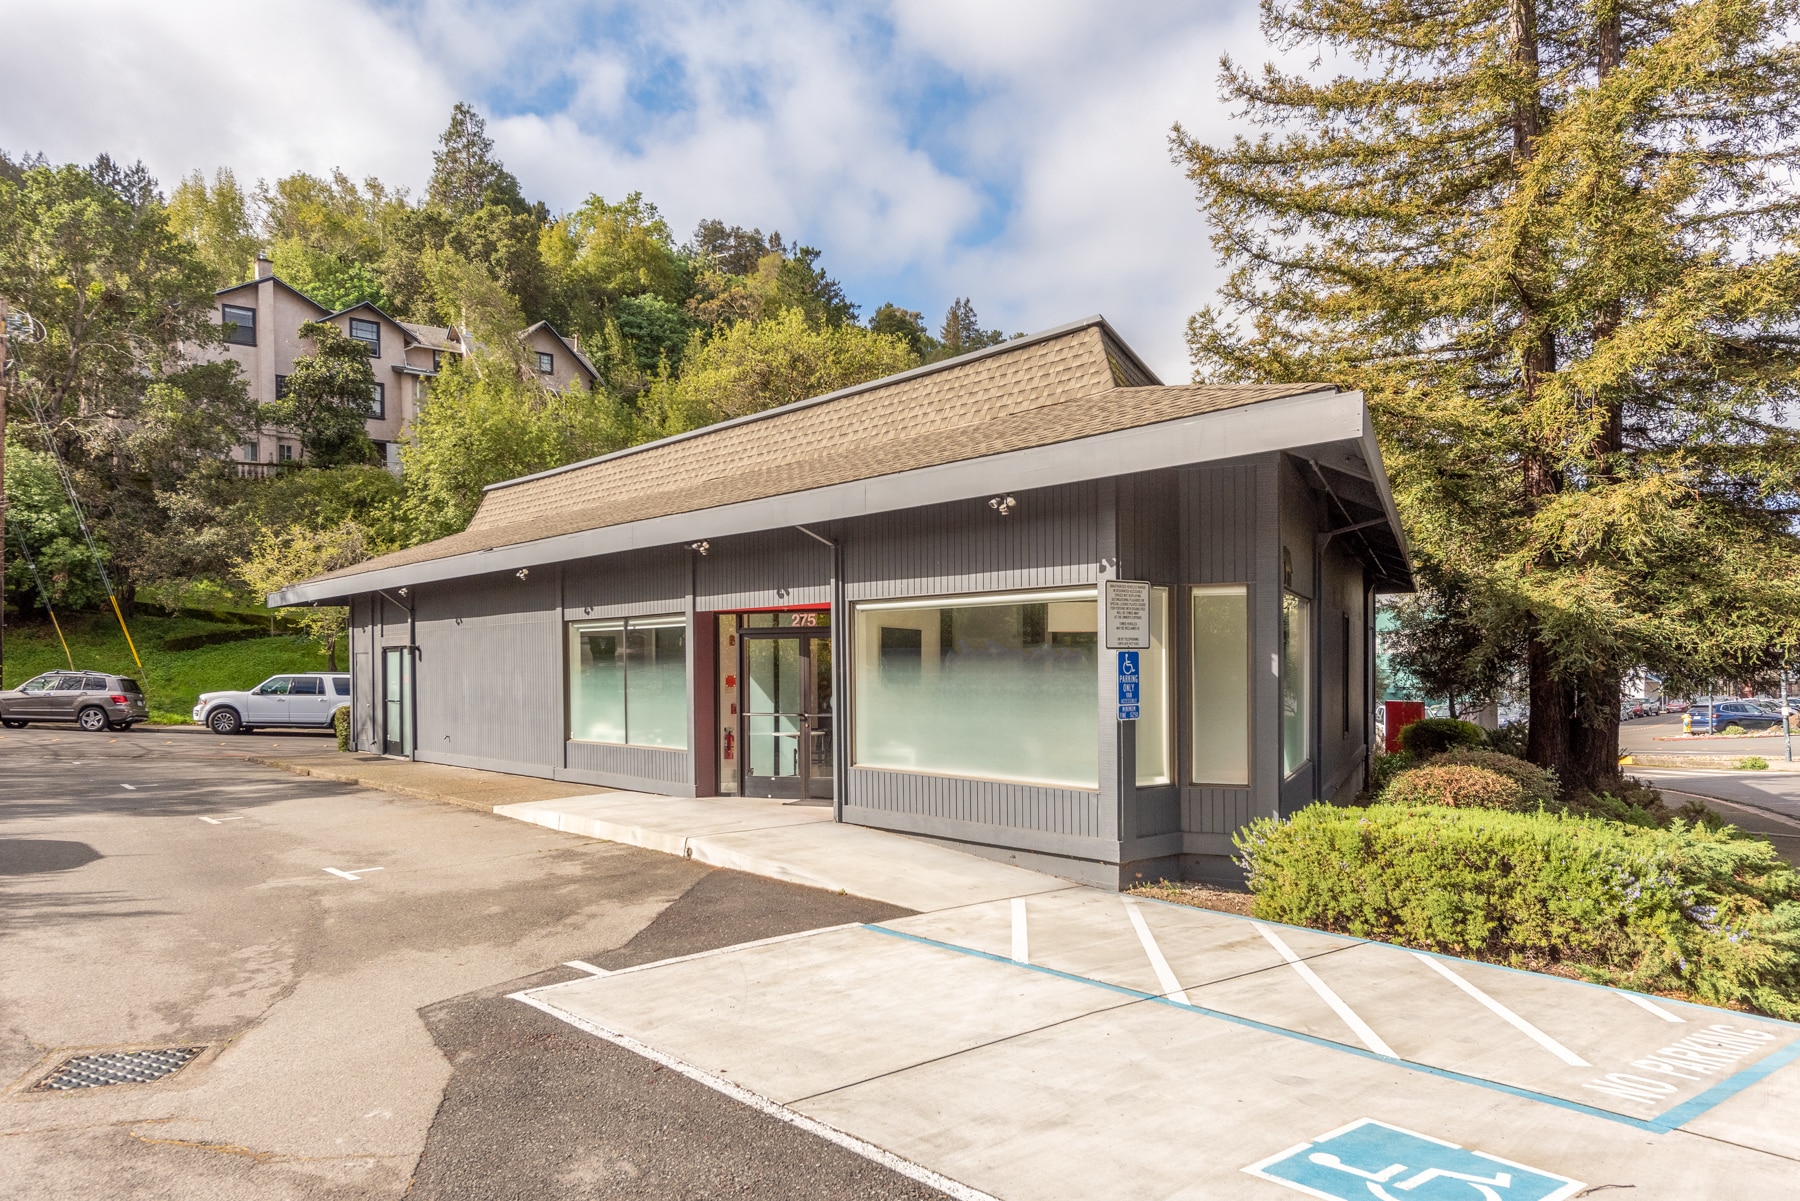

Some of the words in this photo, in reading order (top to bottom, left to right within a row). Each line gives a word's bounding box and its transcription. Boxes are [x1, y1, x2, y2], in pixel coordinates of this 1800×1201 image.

[791, 613, 816, 627] 275
[1120, 675, 1138, 683] PARKING
[1122, 684, 1135, 692] ONLY
[1630, 1024, 1777, 1081] PARKING
[1581, 1072, 1680, 1105] NO
